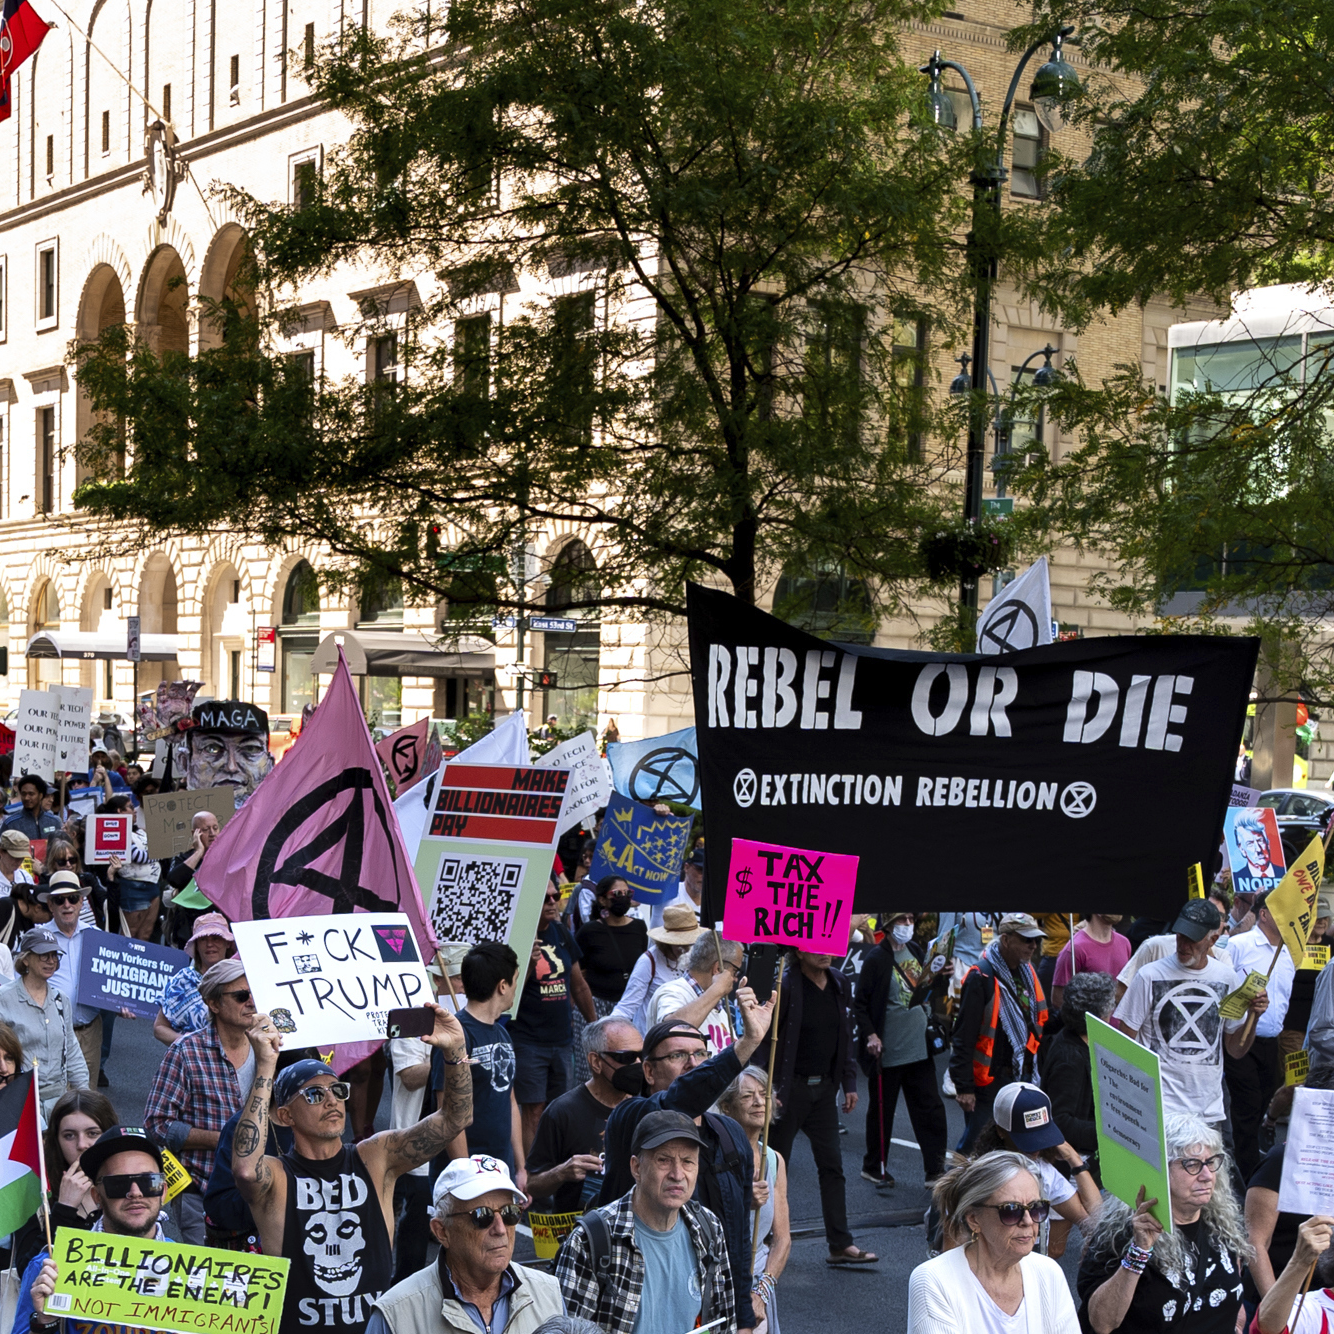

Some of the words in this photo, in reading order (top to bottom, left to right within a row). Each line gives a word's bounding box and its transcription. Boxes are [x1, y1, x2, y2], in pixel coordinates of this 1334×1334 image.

[566, 622, 574, 630] St
[67, 704, 84, 713] TECH
[708, 644, 863, 730] REBEL
[910, 663, 1019, 737] OR
[1063, 671, 1194, 753] DIE
[28, 708, 47, 717] OUR
[23, 723, 44, 733] OUR
[64, 720, 86, 730] POWER
[20, 738, 39, 747] OUR
[60, 735, 85, 744] FUTURE
[512, 768, 570, 792] MAKE
[760, 774, 903, 806] EXTINCTION
[916, 776, 1059, 810] REBELLION
[434, 788, 564, 818] BILLIONAIRES
[429, 814, 468, 837] PAY
[757, 850, 825, 884] TAX
[767, 882, 820, 911] THE
[99, 946, 120, 959] New
[122, 951, 158, 969] Yorkers
[160, 960, 174, 973] for
[275, 973, 422, 1021] TRUMP
[1108, 1077, 1119, 1090] The
[1129, 1075, 1141, 1088] Bad
[1141, 1081, 1150, 1094] for
[1109, 1091, 1143, 1117] environment
[1110, 1103, 1122, 1116] free
[1122, 1108, 1140, 1127] speech
[1112, 1125, 1141, 1150] democracy
[295, 1172, 368, 1211] BED
[65, 1237, 284, 1291] BILLIONAIRES
[64, 1270, 105, 1287] ARE
[118, 1275, 156, 1294] THE
[167, 1281, 271, 1311] ENEMY!
[74, 1298, 121, 1316] NOT
